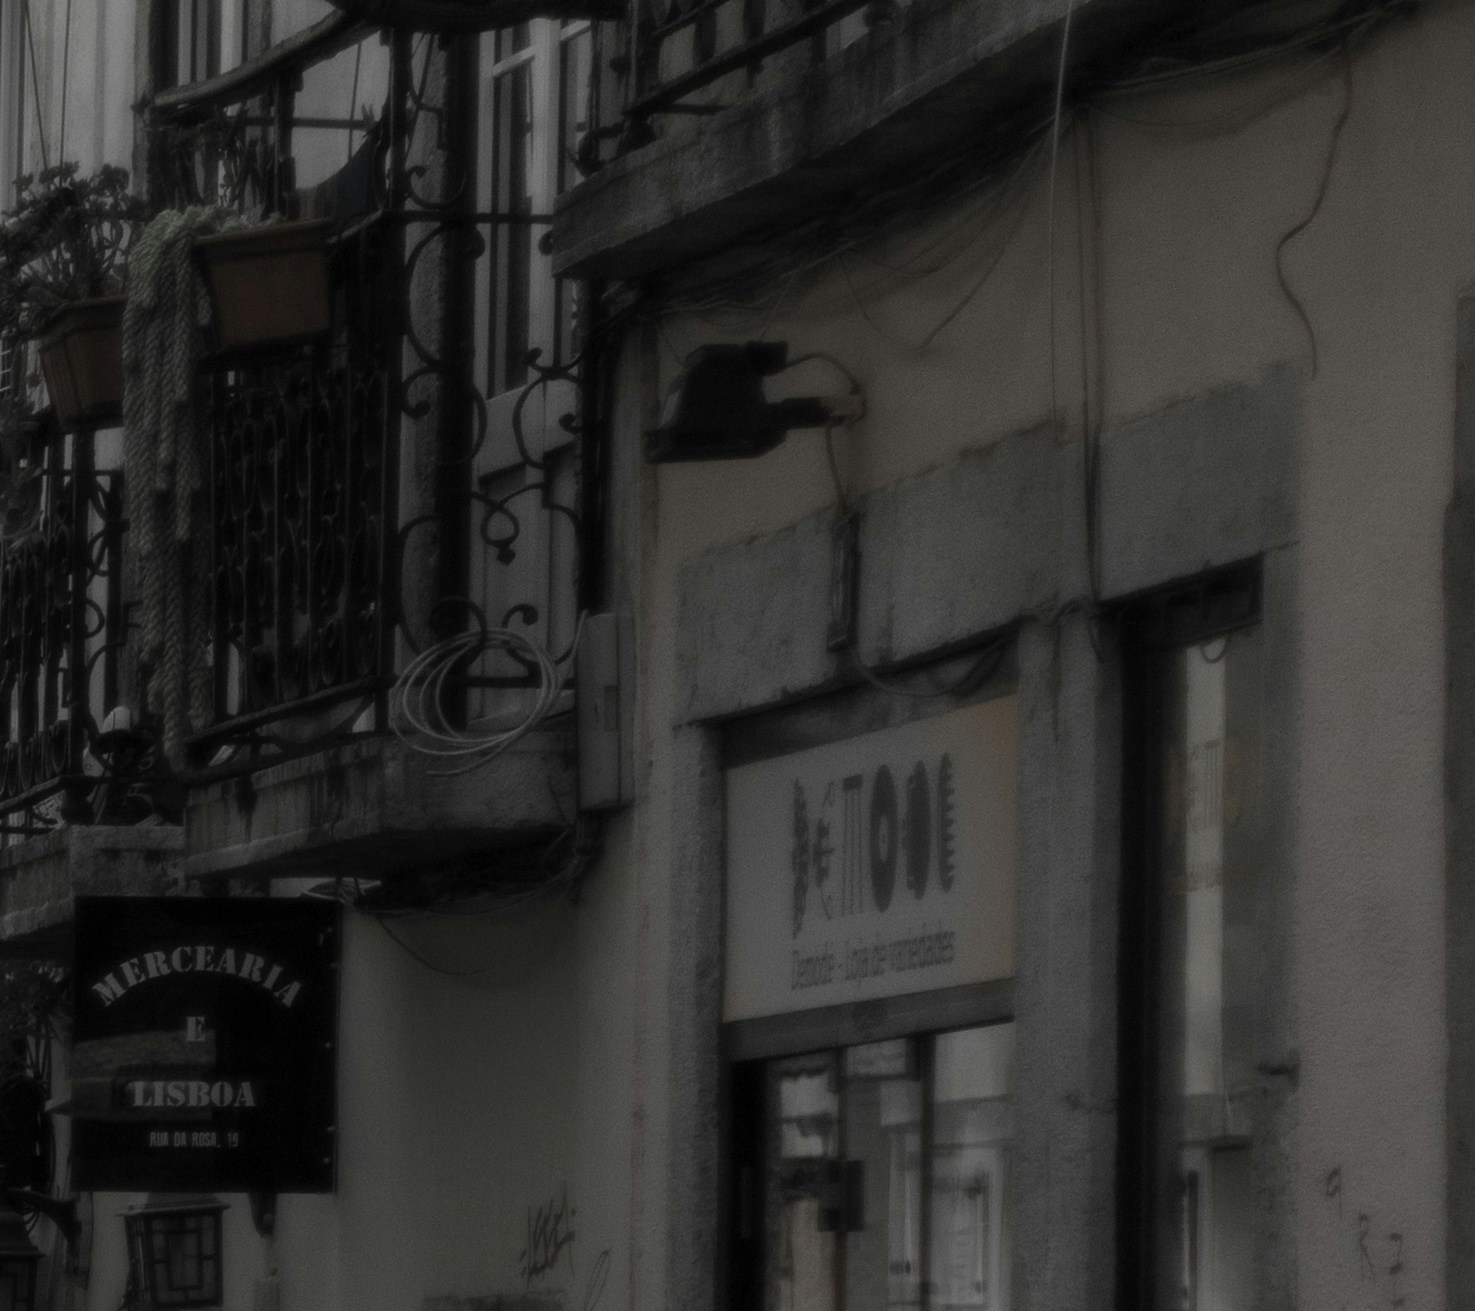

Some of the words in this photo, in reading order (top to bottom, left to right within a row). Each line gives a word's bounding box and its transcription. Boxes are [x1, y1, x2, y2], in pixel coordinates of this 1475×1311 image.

[92, 945, 302, 1007] MERCEARIA
[186, 1016, 205, 1042] E
[130, 1080, 256, 1107] LISBOA
[150, 1132, 169, 1147] RUA
[174, 1132, 187, 1147] DA
[227, 1132, 239, 1147] 19
